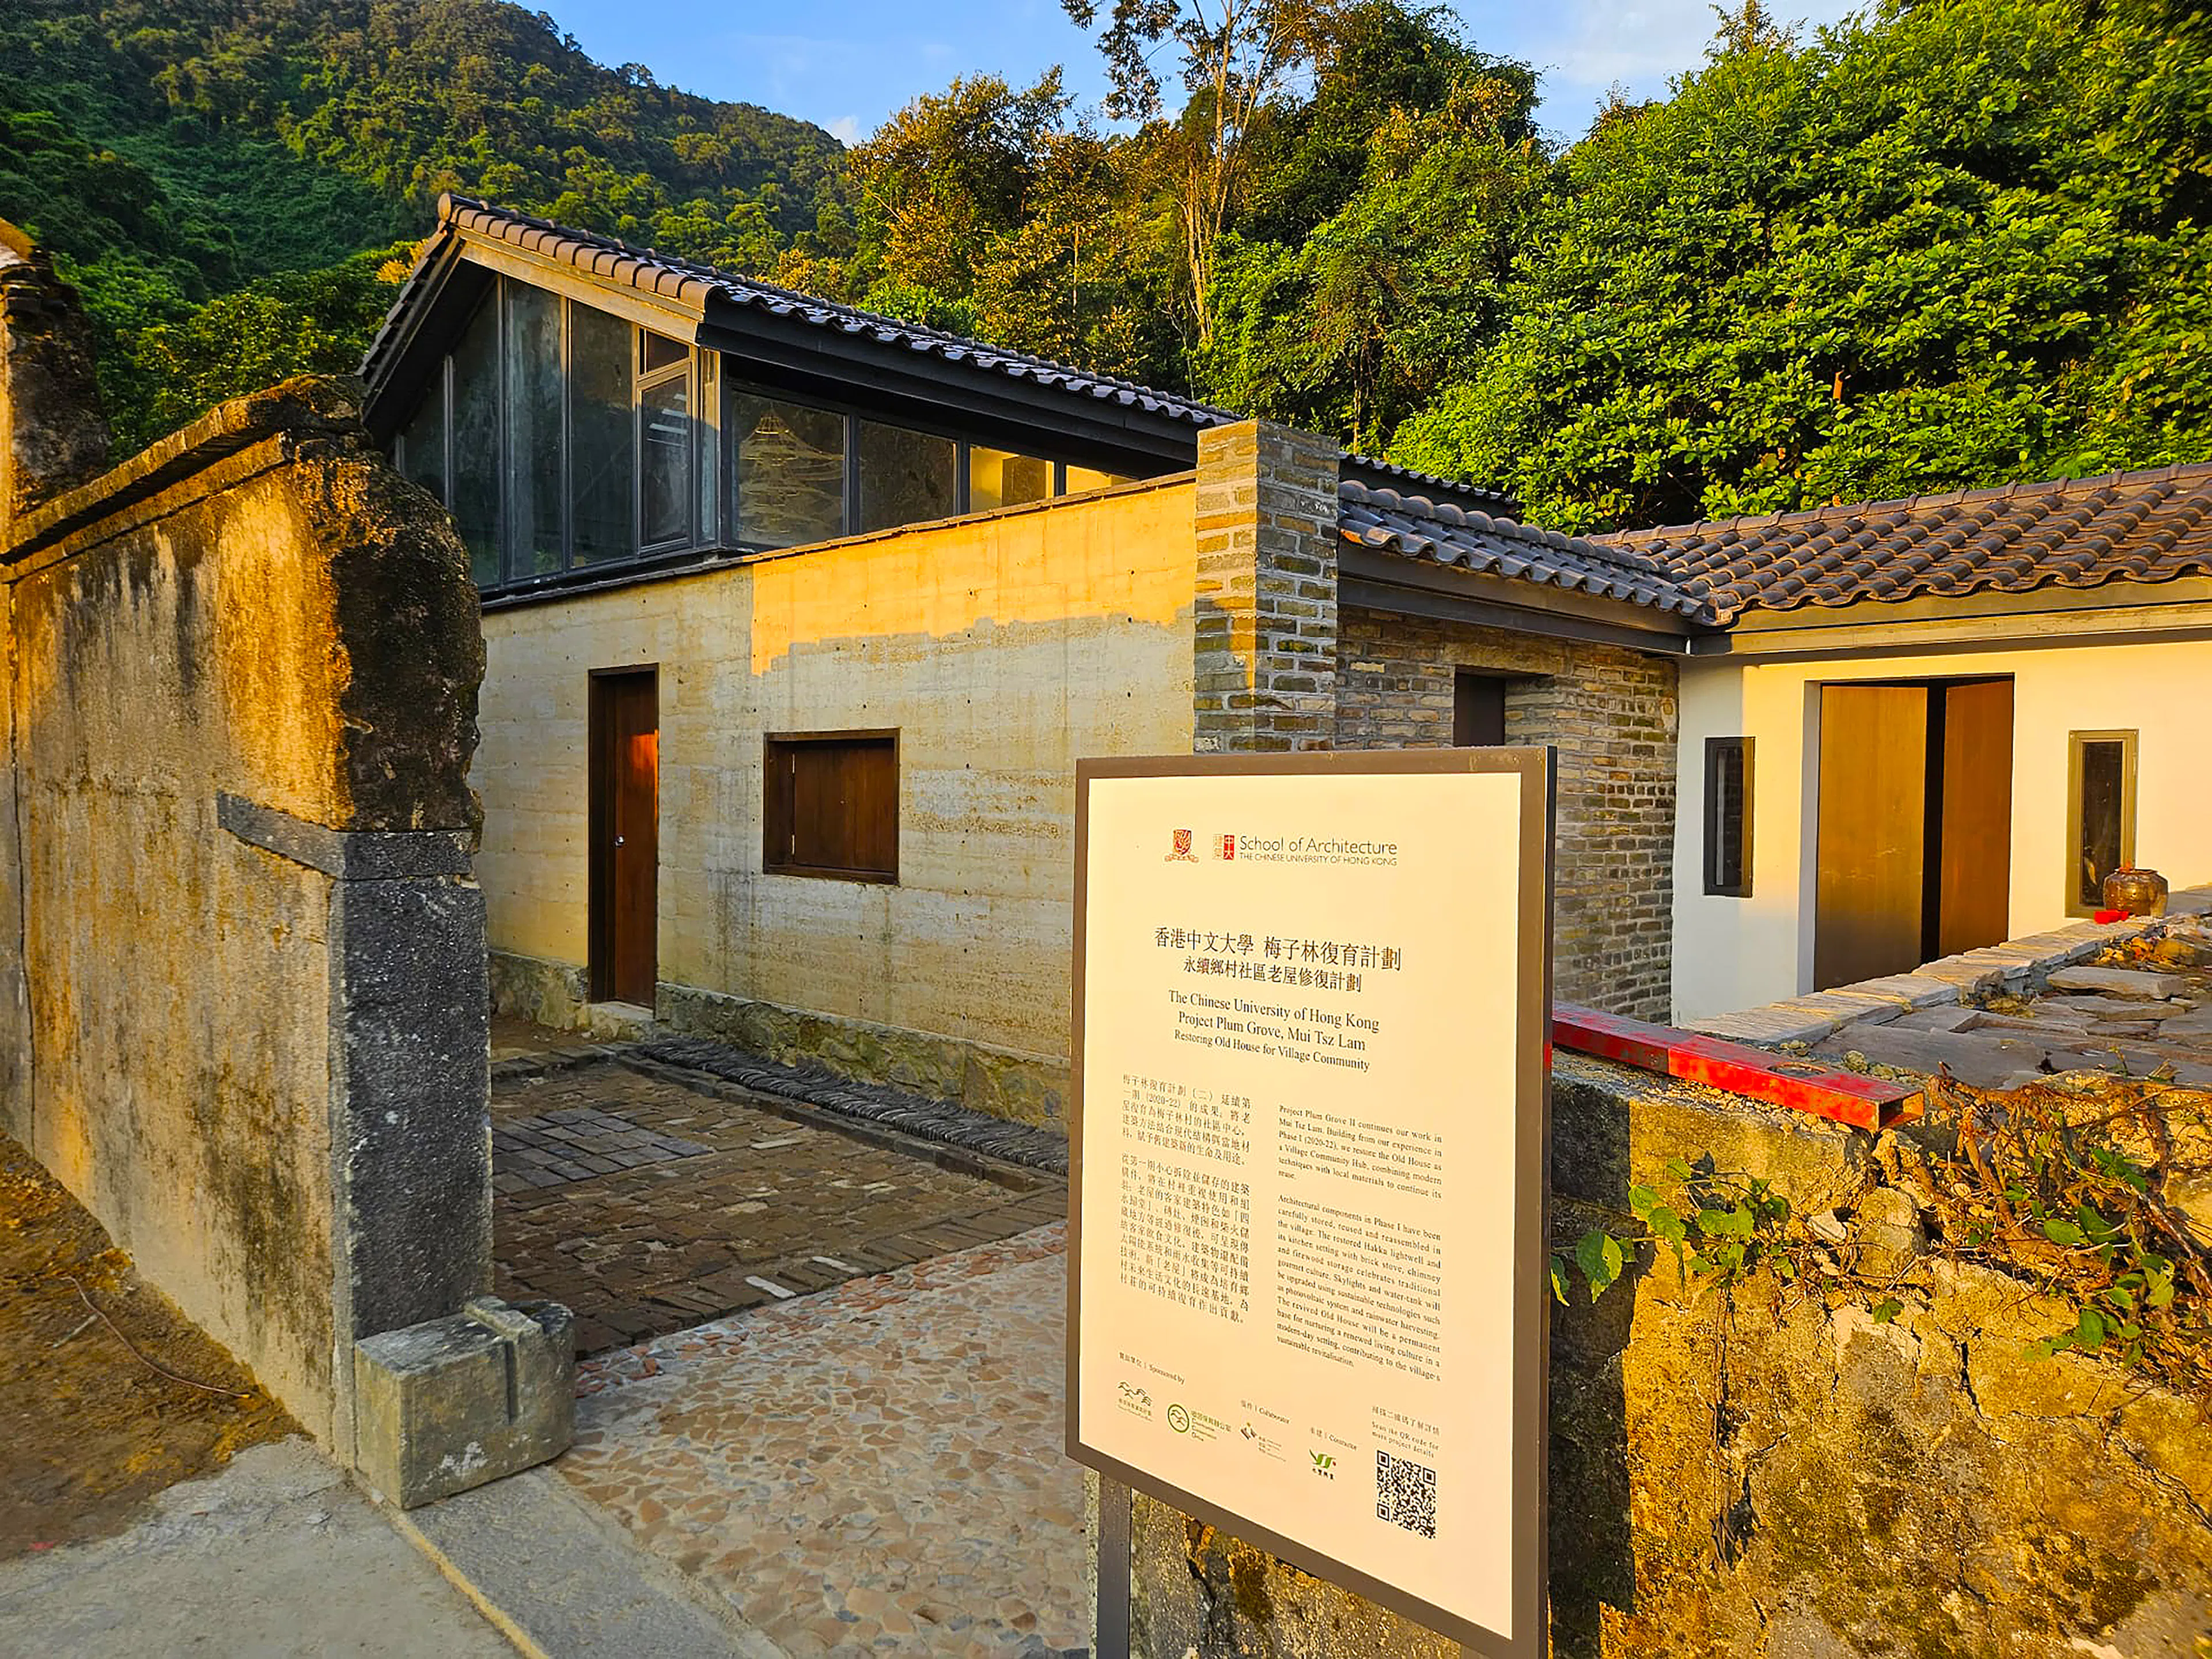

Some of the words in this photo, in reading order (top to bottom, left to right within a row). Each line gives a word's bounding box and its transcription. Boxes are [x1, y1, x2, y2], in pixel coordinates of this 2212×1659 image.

[1240, 835, 1283, 851] School
[1289, 837, 1303, 852] of
[1305, 838, 1397, 855] Architecture
[1240, 852, 1252, 861] THE
[1254, 853, 1284, 861] CHINESE
[1286, 854, 1328, 863] UNIVERSITY
[1330, 855, 1340, 863] OF
[1343, 857, 1369, 865] HONG
[1372, 857, 1396, 866] KONG
[1154, 927, 1253, 956] 香港中文大學
[1263, 935, 1400, 971] 梅子林復育計劃
[1183, 955, 1361, 993] 永續鄉村社區老屋修復計劃
[1168, 989, 1187, 1003] The
[1190, 993, 1230, 1010] Chinese
[1234, 998, 1290, 1021] University
[1293, 1007, 1307, 1020] of
[1309, 1008, 1342, 1029] Hong
[1346, 1013, 1378, 1033] Kong
[1179, 1010, 1213, 1028] Project
[1217, 1016, 1243, 1032] Plum
[1247, 1021, 1283, 1040] Grove,
[1288, 1027, 1310, 1042] Mui
[1315, 1030, 1334, 1046] Tsz
[1338, 1033, 1365, 1051] Lam
[1175, 1029, 1213, 1047] Restoring
[1214, 1036, 1230, 1048] Old
[1233, 1039, 1260, 1052] House
[1263, 1043, 1275, 1055] for
[1278, 1046, 1310, 1063] Village
[1313, 1051, 1369, 1073] Community
[1279, 1104, 1302, 1116] Project
[1305, 1109, 1322, 1120] Plum
[1325, 1113, 1346, 1124] Grove
[1349, 1118, 1355, 1126] II
[1358, 1122, 1392, 1134] continues
[1411, 1131, 1430, 1141] work
[1327, 1126, 1355, 1142] Building
[1358, 1132, 1375, 1144] from
[1392, 1142, 1431, 1154] experience
[1284, 1143, 1308, 1157] Village
[1310, 1150, 1349, 1166] Community
[1372, 1165, 1410, 1180] combining
[1412, 1173, 1441, 1185] modern
[1378, 1150, 1389, 1160] the
[1392, 1153, 1405, 1163] Old
[1408, 1156, 1431, 1168] House
[1315, 1164, 1330, 1174] with
[1332, 1168, 1349, 1178] local
[1352, 1173, 1384, 1185] materials
[1396, 1184, 1428, 1196] continue
[1431, 1188, 1441, 1198] its
[1278, 1194, 1319, 1210] Architectural
[1364, 1214, 1372, 1224] in
[1403, 1224, 1421, 1236] have
[1423, 1229, 1440, 1241] been
[1278, 1209, 1307, 1222] carefully
[1338, 1224, 1362, 1234] reused
[1365, 1230, 1378, 1239] and
[1381, 1234, 1429, 1252] reassembled
[1433, 1245, 1440, 1255] in
[1278, 1219, 1287, 1228] the
[1318, 1229, 1331, 1240] The
[1333, 1236, 1361, 1248] restored
[1364, 1241, 1387, 1255] Hakka
[1390, 1248, 1423, 1264] lightwell
[1427, 1260, 1440, 1268] and
[1277, 1247, 1289, 1255] and
[1327, 1260, 1353, 1273] storage
[1357, 1268, 1395, 1284] celebrates
[1398, 1279, 1440, 1296] traditional
[1316, 1244, 1339, 1257] setting
[1342, 1251, 1357, 1261] with
[1360, 1254, 1378, 1266] brick
[1382, 1262, 1404, 1274] stove,
[1407, 1267, 1440, 1285] chimney
[1277, 1270, 1285, 1279] be
[1286, 1275, 1315, 1288] upgraded
[1317, 1283, 1335, 1296] using
[1376, 1301, 1421, 1319] technologies
[1423, 1315, 1440, 1325] such
[1327, 1300, 1349, 1312] system
[1351, 1308, 1363, 1316] and
[1334, 1274, 1366, 1289] Skylights
[1369, 1286, 1381, 1294] and
[1425, 1301, 1440, 1311] will
[1277, 1296, 1290, 1306] The
[1292, 1302, 1317, 1315] revived
[1320, 1310, 1334, 1320] Old
[1336, 1314, 1359, 1327] House
[1362, 1324, 1376, 1334] will
[1380, 1327, 1388, 1338] be
[1399, 1335, 1440, 1353] permanent
[1277, 1308, 1291, 1320] base
[1293, 1313, 1302, 1323] for
[1304, 1319, 1335, 1335] nurturing
[1343, 1331, 1372, 1346] renewed
[1374, 1339, 1395, 1355] living
[1397, 1349, 1423, 1362] culture
[1425, 1355, 1433, 1365] in
[1342, 1344, 1383, 1365] contributing
[1386, 1358, 1393, 1366] to
[1395, 1361, 1406, 1370] the
